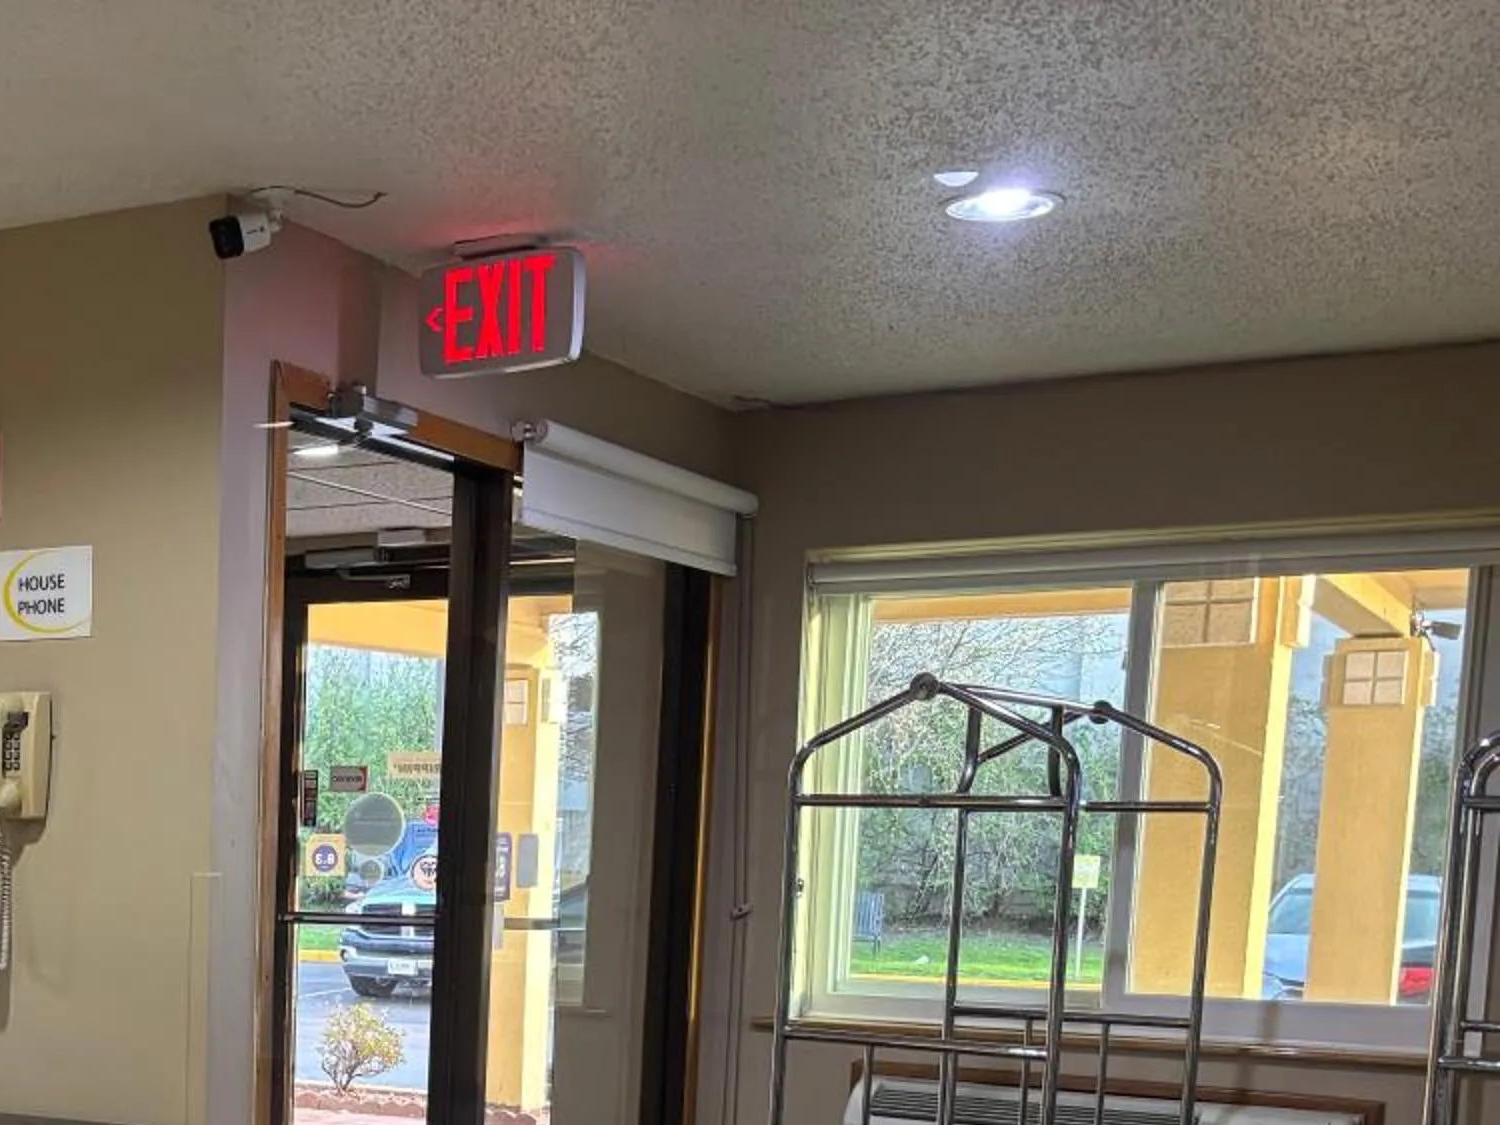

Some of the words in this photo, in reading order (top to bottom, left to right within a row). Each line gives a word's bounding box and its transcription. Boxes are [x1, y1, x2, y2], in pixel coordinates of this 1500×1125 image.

[443, 254, 556, 365] EXIT
[18, 573, 65, 592] HOUSE
[17, 597, 65, 616] PHONE
